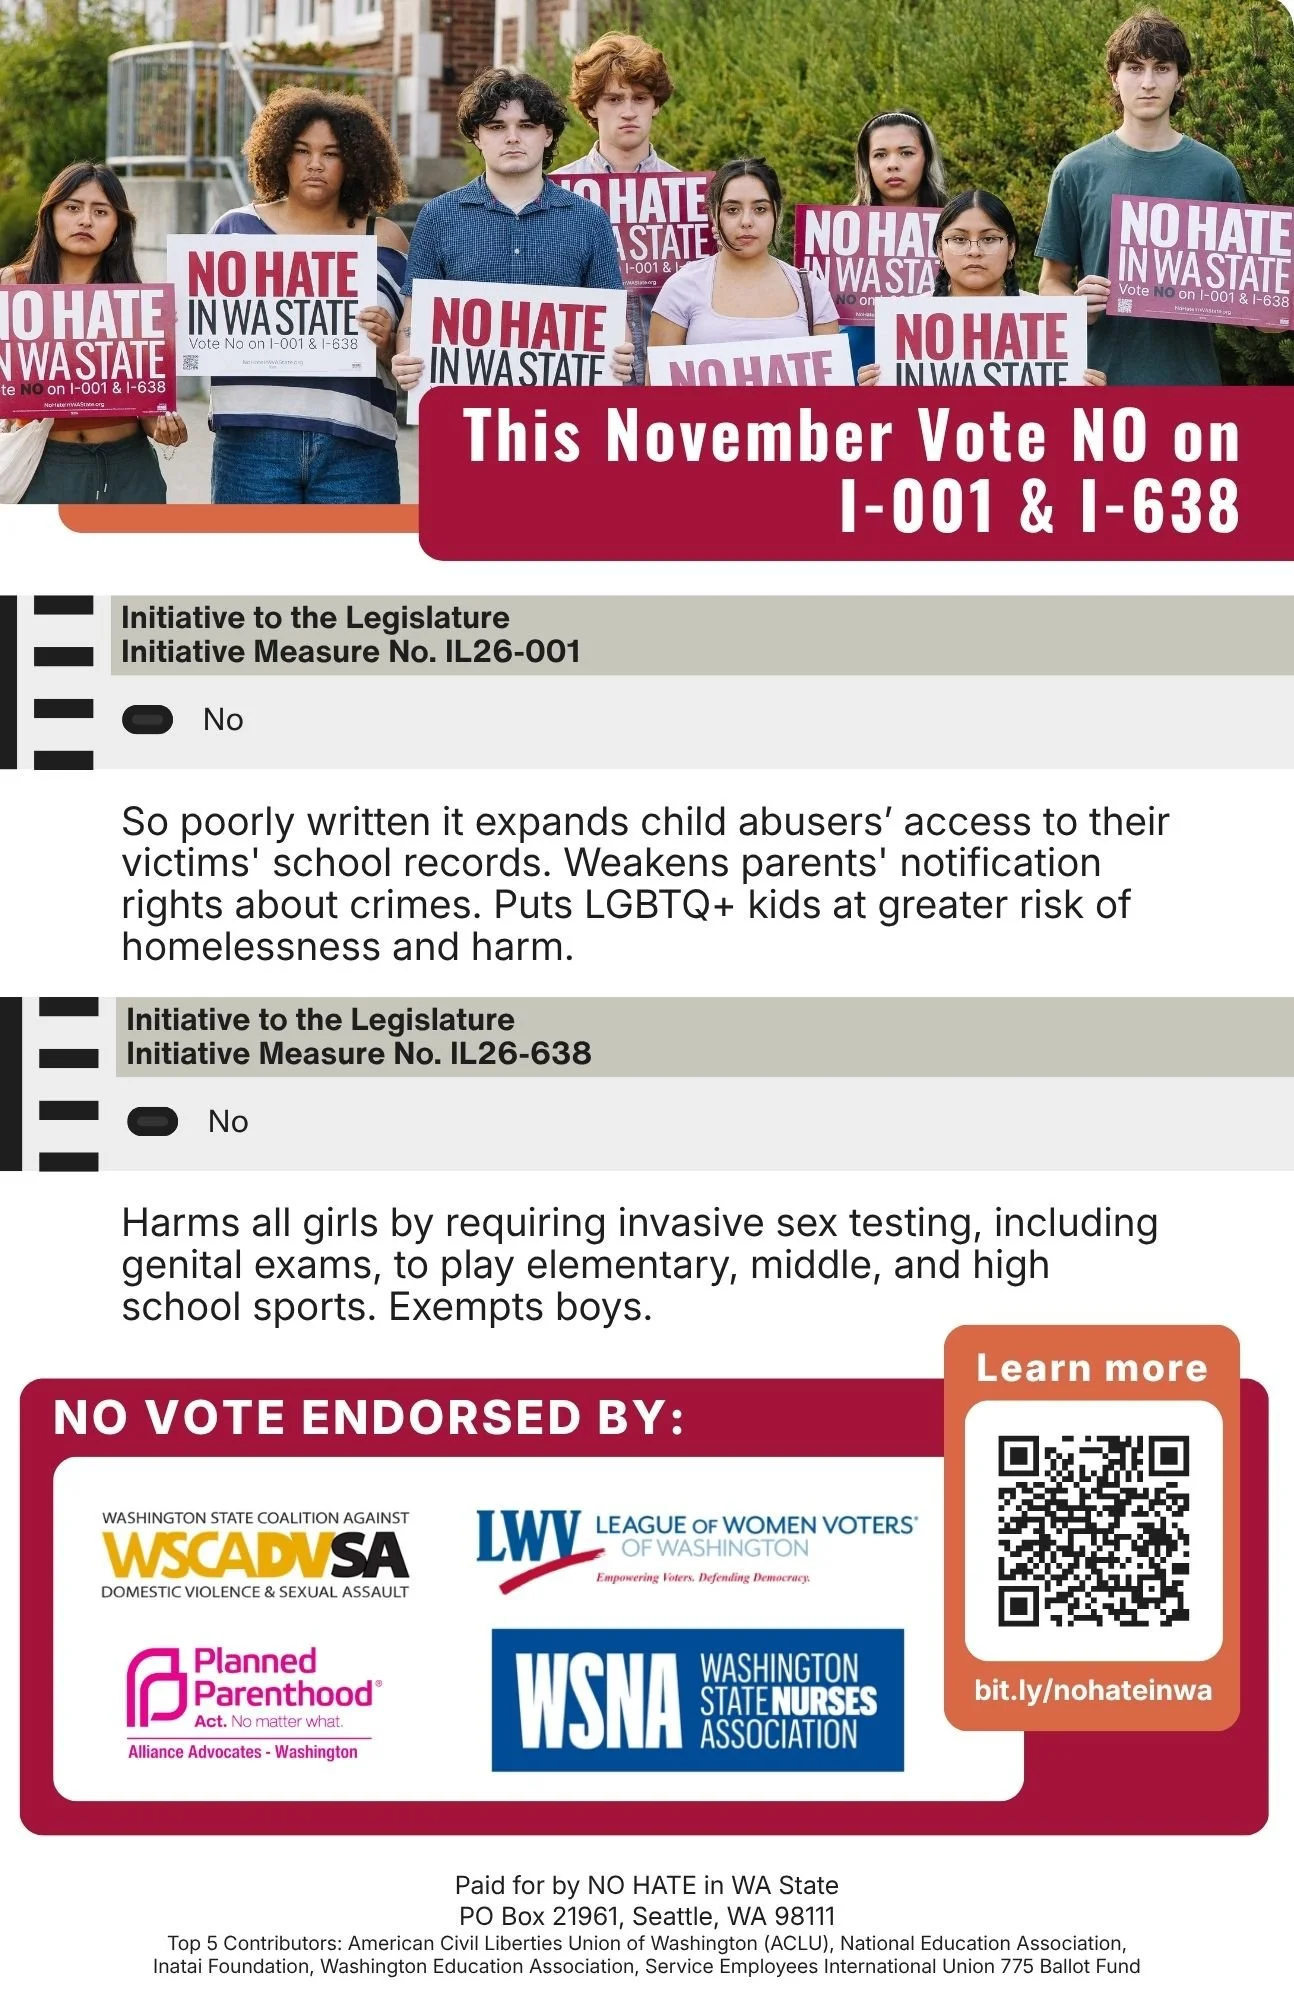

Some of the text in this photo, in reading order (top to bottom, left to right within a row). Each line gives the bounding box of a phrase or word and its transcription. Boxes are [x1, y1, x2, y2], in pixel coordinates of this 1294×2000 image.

[609, 177, 708, 223] HATE
[629, 224, 709, 261] STATE
[805, 210, 941, 258] NO HAT
[1121, 201, 1292, 257] NO HATE
[188, 250, 358, 298] NO HATE
[625, 262, 658, 275] I-001
[836, 257, 881, 293] WA
[1119, 246, 1291, 294] IN WA STATE
[836, 294, 856, 305] NO
[1119, 283, 1289, 307] Vote NO on I-001 & I-638
[53, 290, 165, 340] HATE
[188, 300, 358, 335] IN WA STATE
[432, 296, 607, 353] NO HATE
[189, 337, 358, 350] Vote No on I-001 & I-638
[896, 313, 1067, 360] NO HATE
[18, 341, 166, 381] WA STATE
[430, 346, 605, 386] IN WA STATE
[896, 362, 923, 386] IN
[21, 381, 166, 395] NO on I-001 & I-638
[463, 407, 1238, 462] This November Vote NO on
[842, 478, 1238, 533] I-001 & I-638
[123, 605, 509, 636] Initiative to the Legislature
[123, 639, 578, 663] Initiative Measure No. IL26-001
[205, 708, 243, 731] No
[123, 806, 1170, 843] So poorly written it expands child abusers’ access to their
[128, 1041, 591, 1065] Initiative Measure No. IL26-638
[210, 1109, 248, 1133] No
[123, 1291, 651, 1328] school sports. Exempts boys.
[978, 1353, 1207, 1382] Learn more
[55, 1399, 682, 1435] NO VOTE ENDORSED BY:
[103, 1512, 409, 1524] WASHINGTON STATE COALITION AGAINST
[597, 1516, 686, 1534] LEAGUE
[692, 1519, 718, 1534] OF
[723, 1516, 816, 1534] WOMEN
[477, 1510, 581, 1561] LWV
[623, 1539, 807, 1556] OF WASHINGTON
[102, 1586, 409, 1598] DOMESTIC VIOLENCE & SEXUAL ASSAULT
[597, 1573, 809, 1584] Empowering Voters. Defending Democracy.
[195, 1647, 316, 1674] Planned
[701, 1653, 858, 1683] WASHINGTON
[195, 1680, 372, 1706] Parenthood
[515, 1652, 683, 1750] WSNA
[700, 1686, 877, 1716] STATE NURSES
[976, 1678, 1212, 1706] bit.ly/nohateinwa
[194, 1715, 343, 1728] Act. No matter what.
[701, 1719, 856, 1749] ASSOCIATION
[128, 1745, 357, 1762] Alliance Advocates Washington
[457, 1875, 838, 1899] Paid for by NO HATE in WA State
[168, 1935, 1126, 1955] Top 5 Contributors: American Civil Liberties Union of Washington (ACLU), National Education Association,
